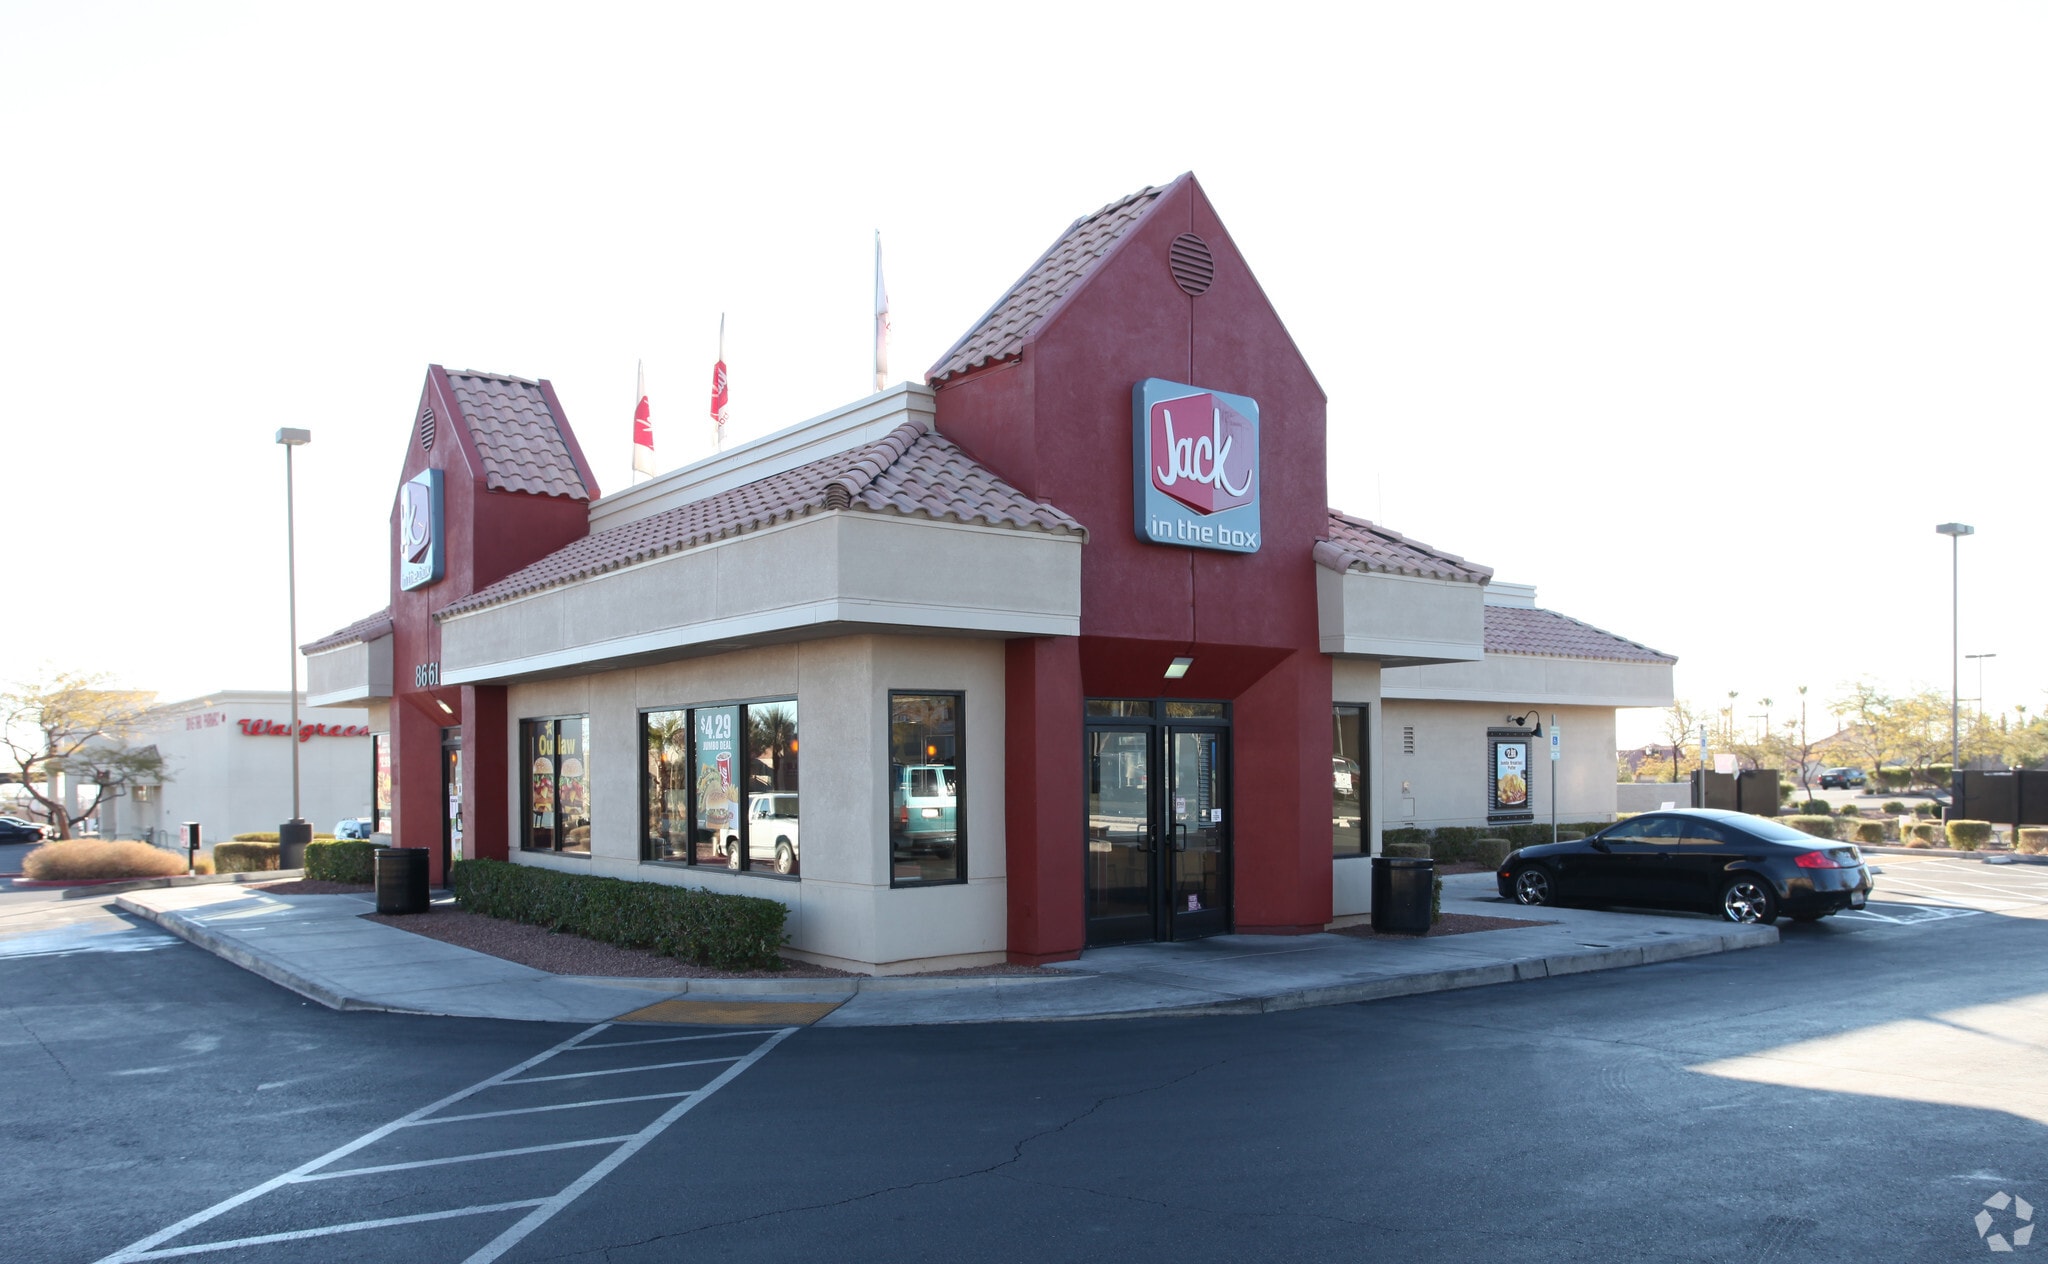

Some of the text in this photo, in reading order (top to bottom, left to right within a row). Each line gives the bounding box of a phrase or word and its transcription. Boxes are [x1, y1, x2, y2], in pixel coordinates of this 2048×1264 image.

[1157, 408, 1252, 497] Jack
[1151, 515, 1257, 547] in the box
[415, 661, 440, 688] 8661
[700, 713, 732, 739] $4.29
[538, 734, 576, 756] Oulaw
[703, 740, 732, 751] JUMBO DEAL
